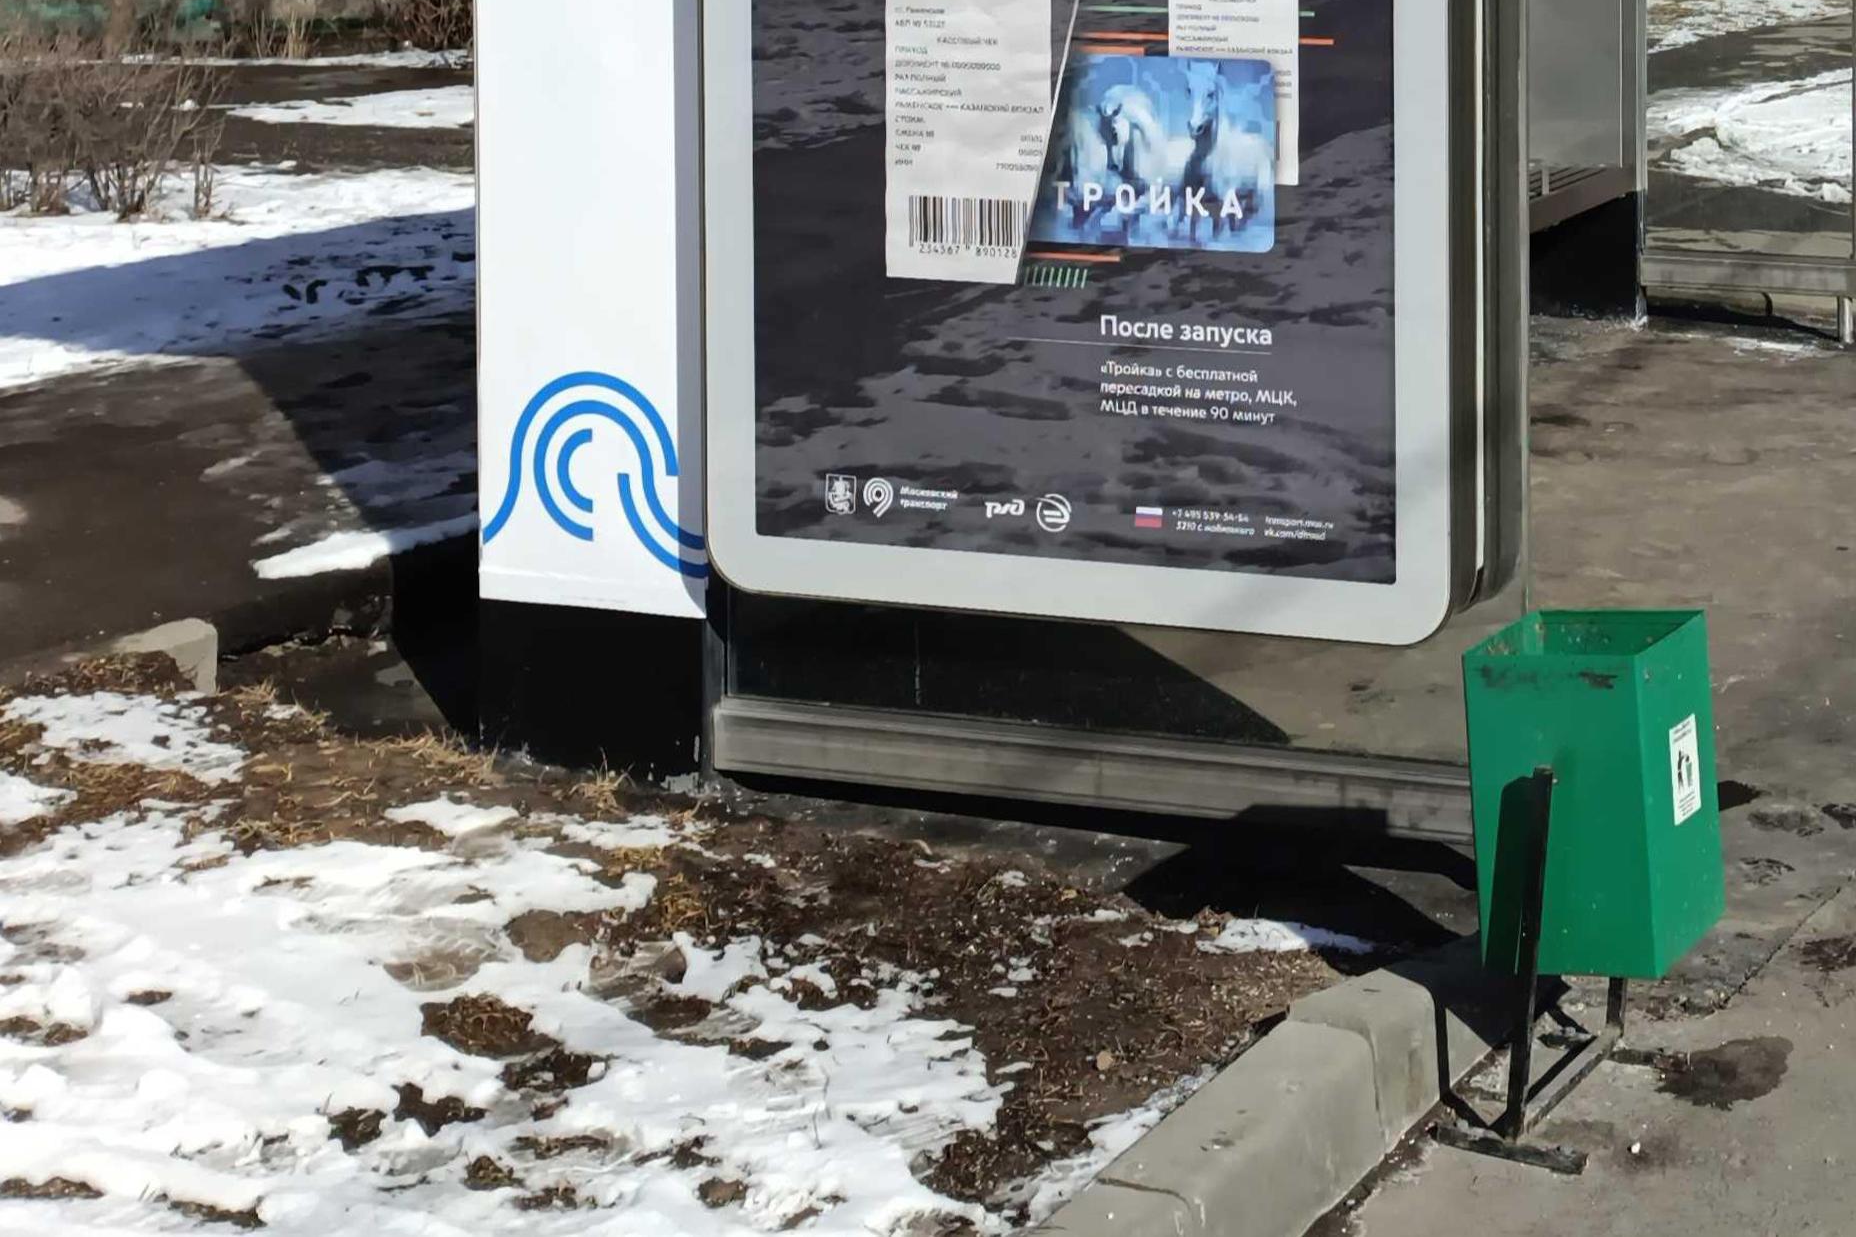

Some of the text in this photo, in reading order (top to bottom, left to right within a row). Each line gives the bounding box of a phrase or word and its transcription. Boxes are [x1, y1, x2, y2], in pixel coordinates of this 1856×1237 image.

[1051, 175, 1245, 220] ТРОЙКА
[1100, 314, 1273, 348] После запуска
[1100, 360, 1258, 383] «Тройка» с бесплатной
[1100, 382, 1298, 408] пересадкой на метро, МЦК,
[1100, 399, 1276, 426] МЦД в течение 90 минут
